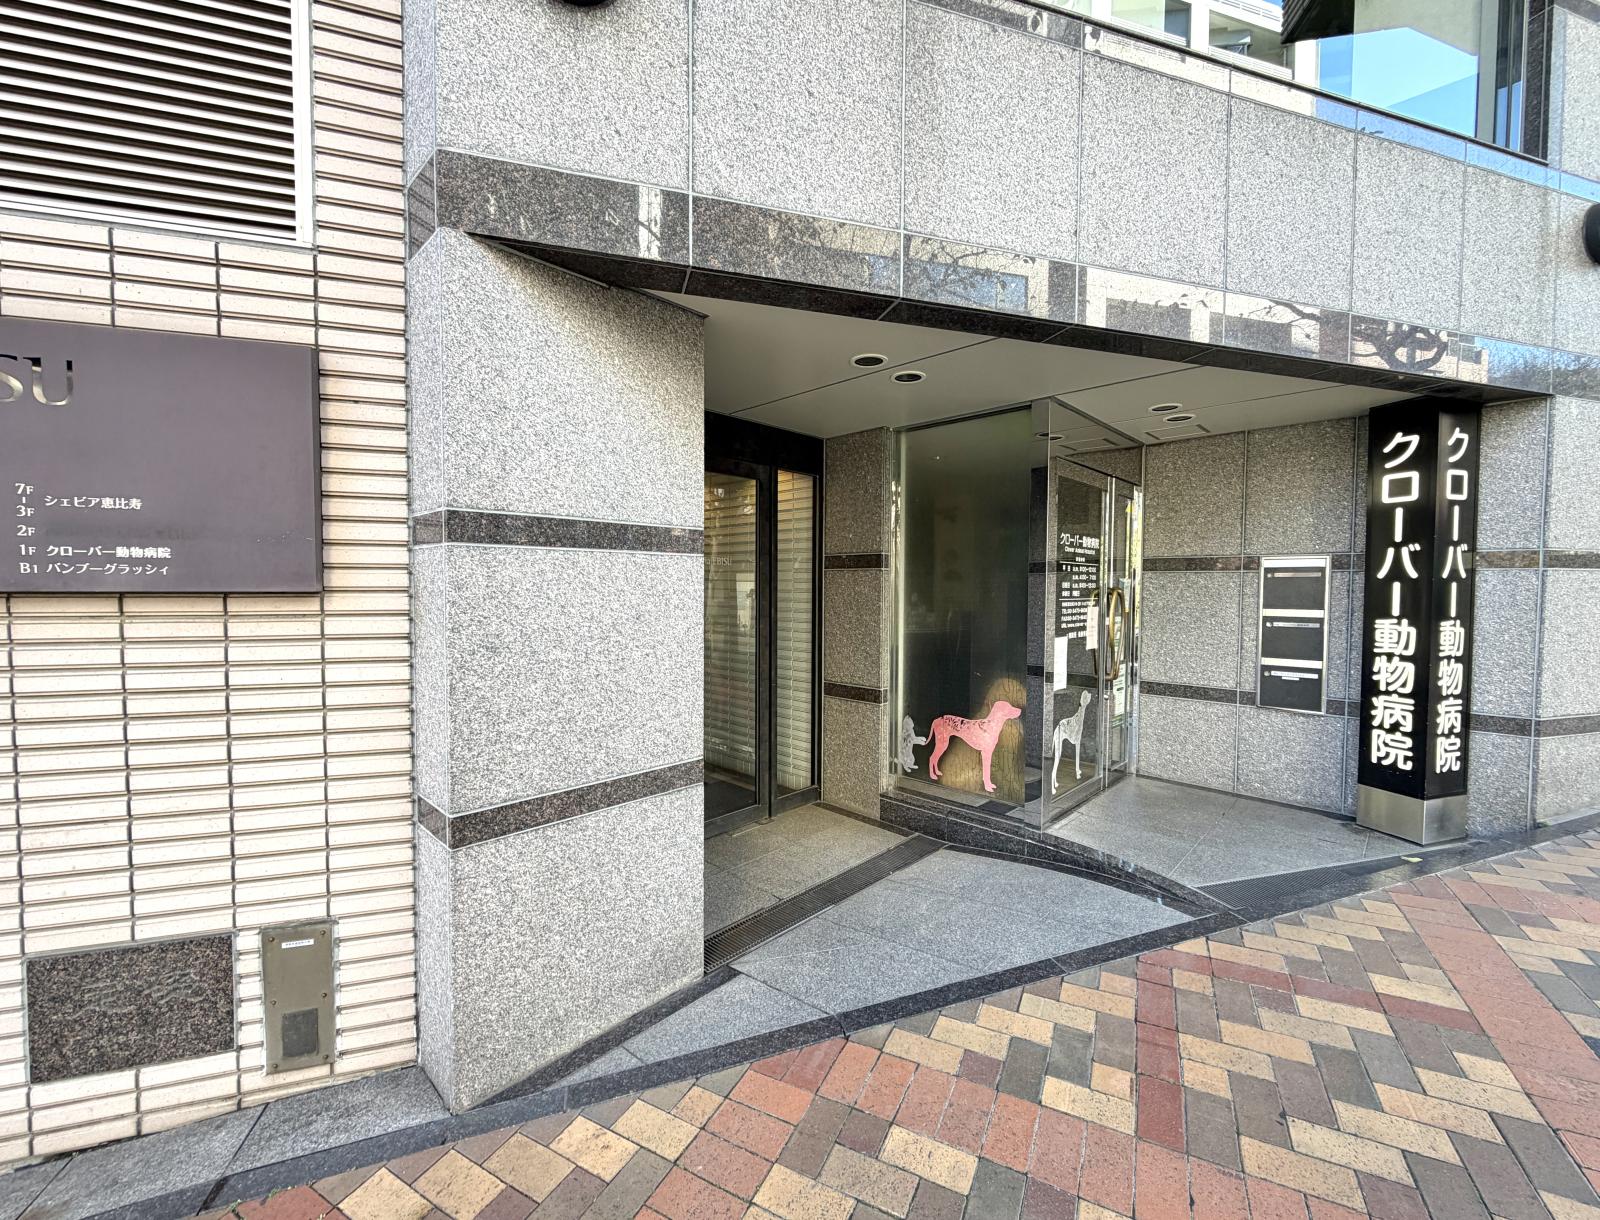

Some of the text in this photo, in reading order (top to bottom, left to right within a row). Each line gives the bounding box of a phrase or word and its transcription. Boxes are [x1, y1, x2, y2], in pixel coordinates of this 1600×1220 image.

[15, 482, 34, 495] 7F
[44, 495, 143, 510] シェビア恵比寿
[16, 505, 35, 517] 3F
[16, 524, 36, 537] 2F
[19, 544, 172, 559] 1F クローバー動物病院
[1370, 432, 1421, 771] クローバー動物病院
[1435, 427, 1469, 774] クローバー動物病院
